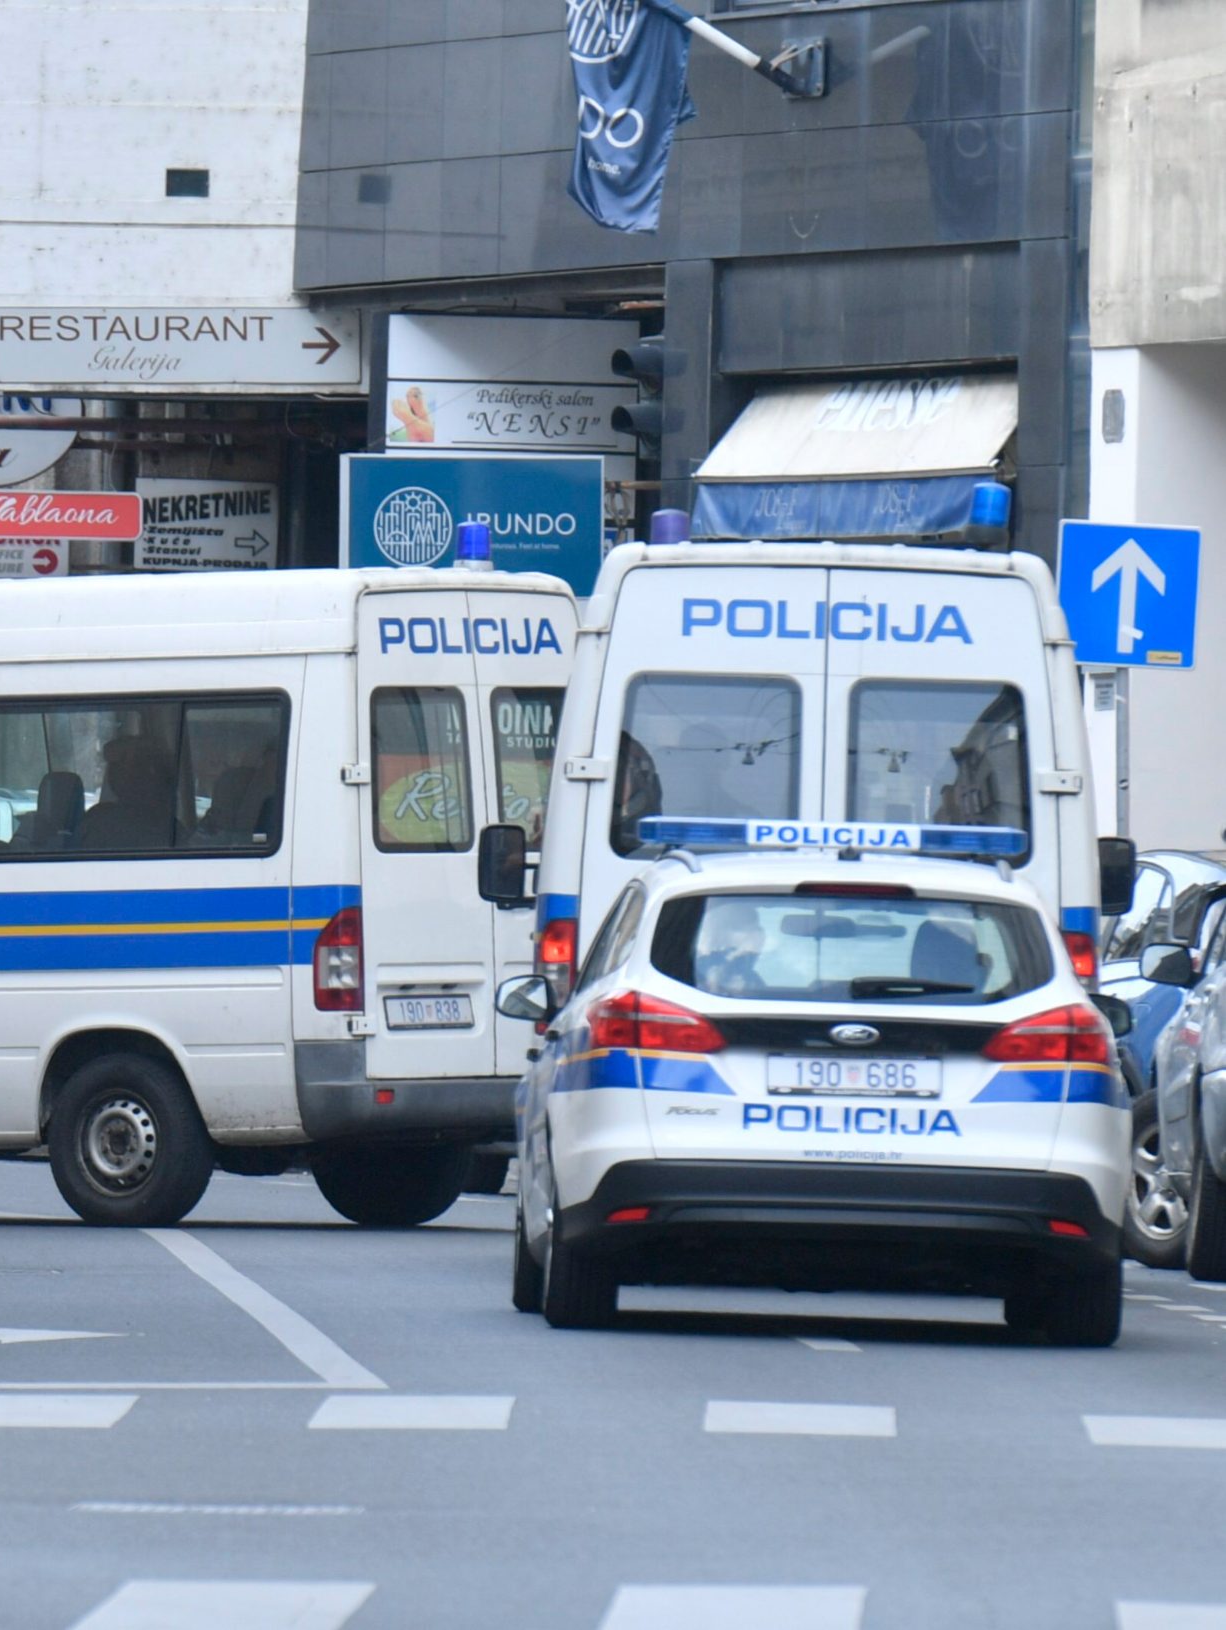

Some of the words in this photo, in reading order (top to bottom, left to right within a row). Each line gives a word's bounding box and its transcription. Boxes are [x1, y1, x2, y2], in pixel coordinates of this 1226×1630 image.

[86, 346, 183, 380] Galerija
[476, 387, 553, 410] Pedikerski
[555, 389, 594, 407] salon
[143, 490, 272, 525] NEKRETNINE
[379, 616, 563, 656] POLICIJA
[682, 597, 974, 646] POLICIJA
[755, 825, 912, 848] POLICIJA
[400, 1001, 425, 1023] 190
[435, 1000, 461, 1021] 838
[795, 1061, 842, 1087] 190
[866, 1062, 917, 1088] 686
[742, 1102, 963, 1137] POLICIJA
[803, 1149, 903, 1161] www.policija.hr
